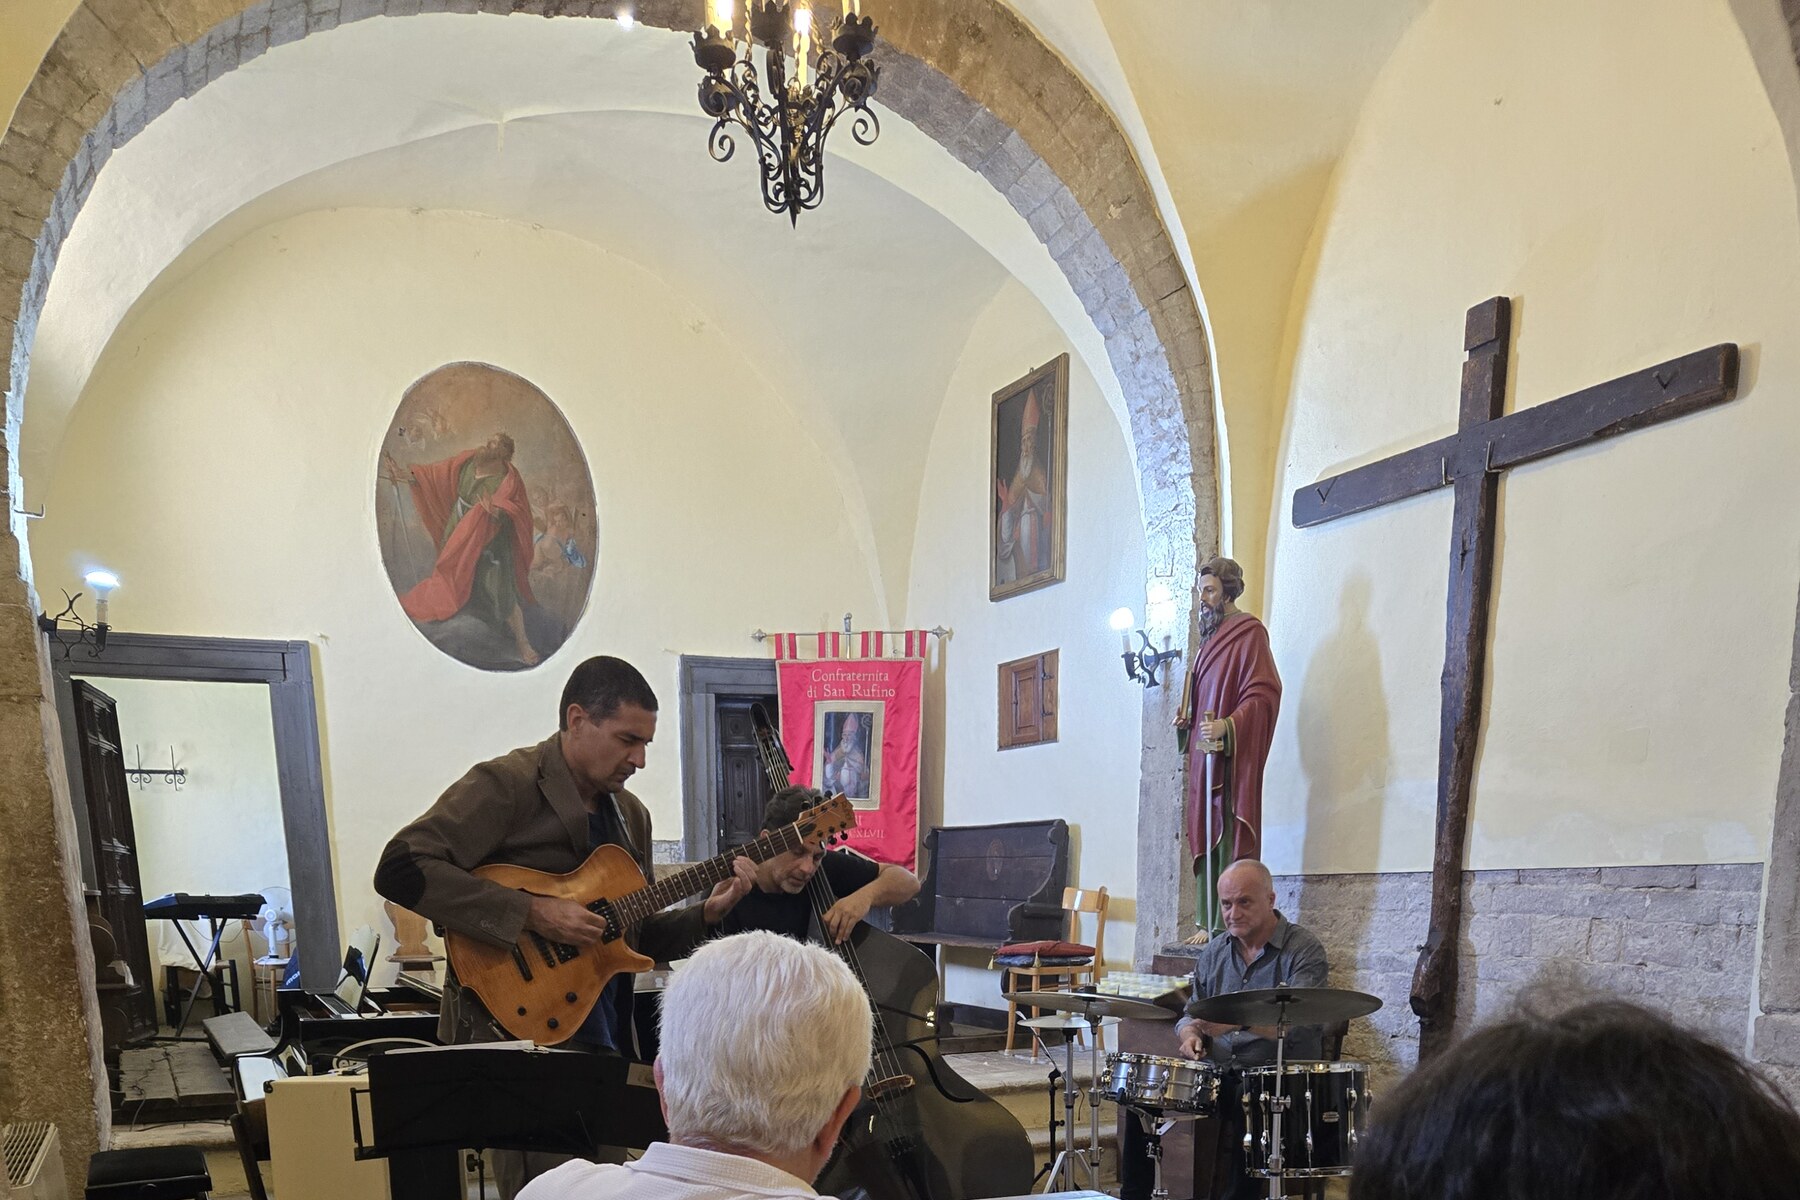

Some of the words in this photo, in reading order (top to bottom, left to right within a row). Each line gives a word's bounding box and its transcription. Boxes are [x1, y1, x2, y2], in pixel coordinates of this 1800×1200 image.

[811, 668, 889, 682] Confraternita
[807, 685, 817, 698] di
[823, 684, 845, 697] San
[852, 684, 896, 697] Rufino
